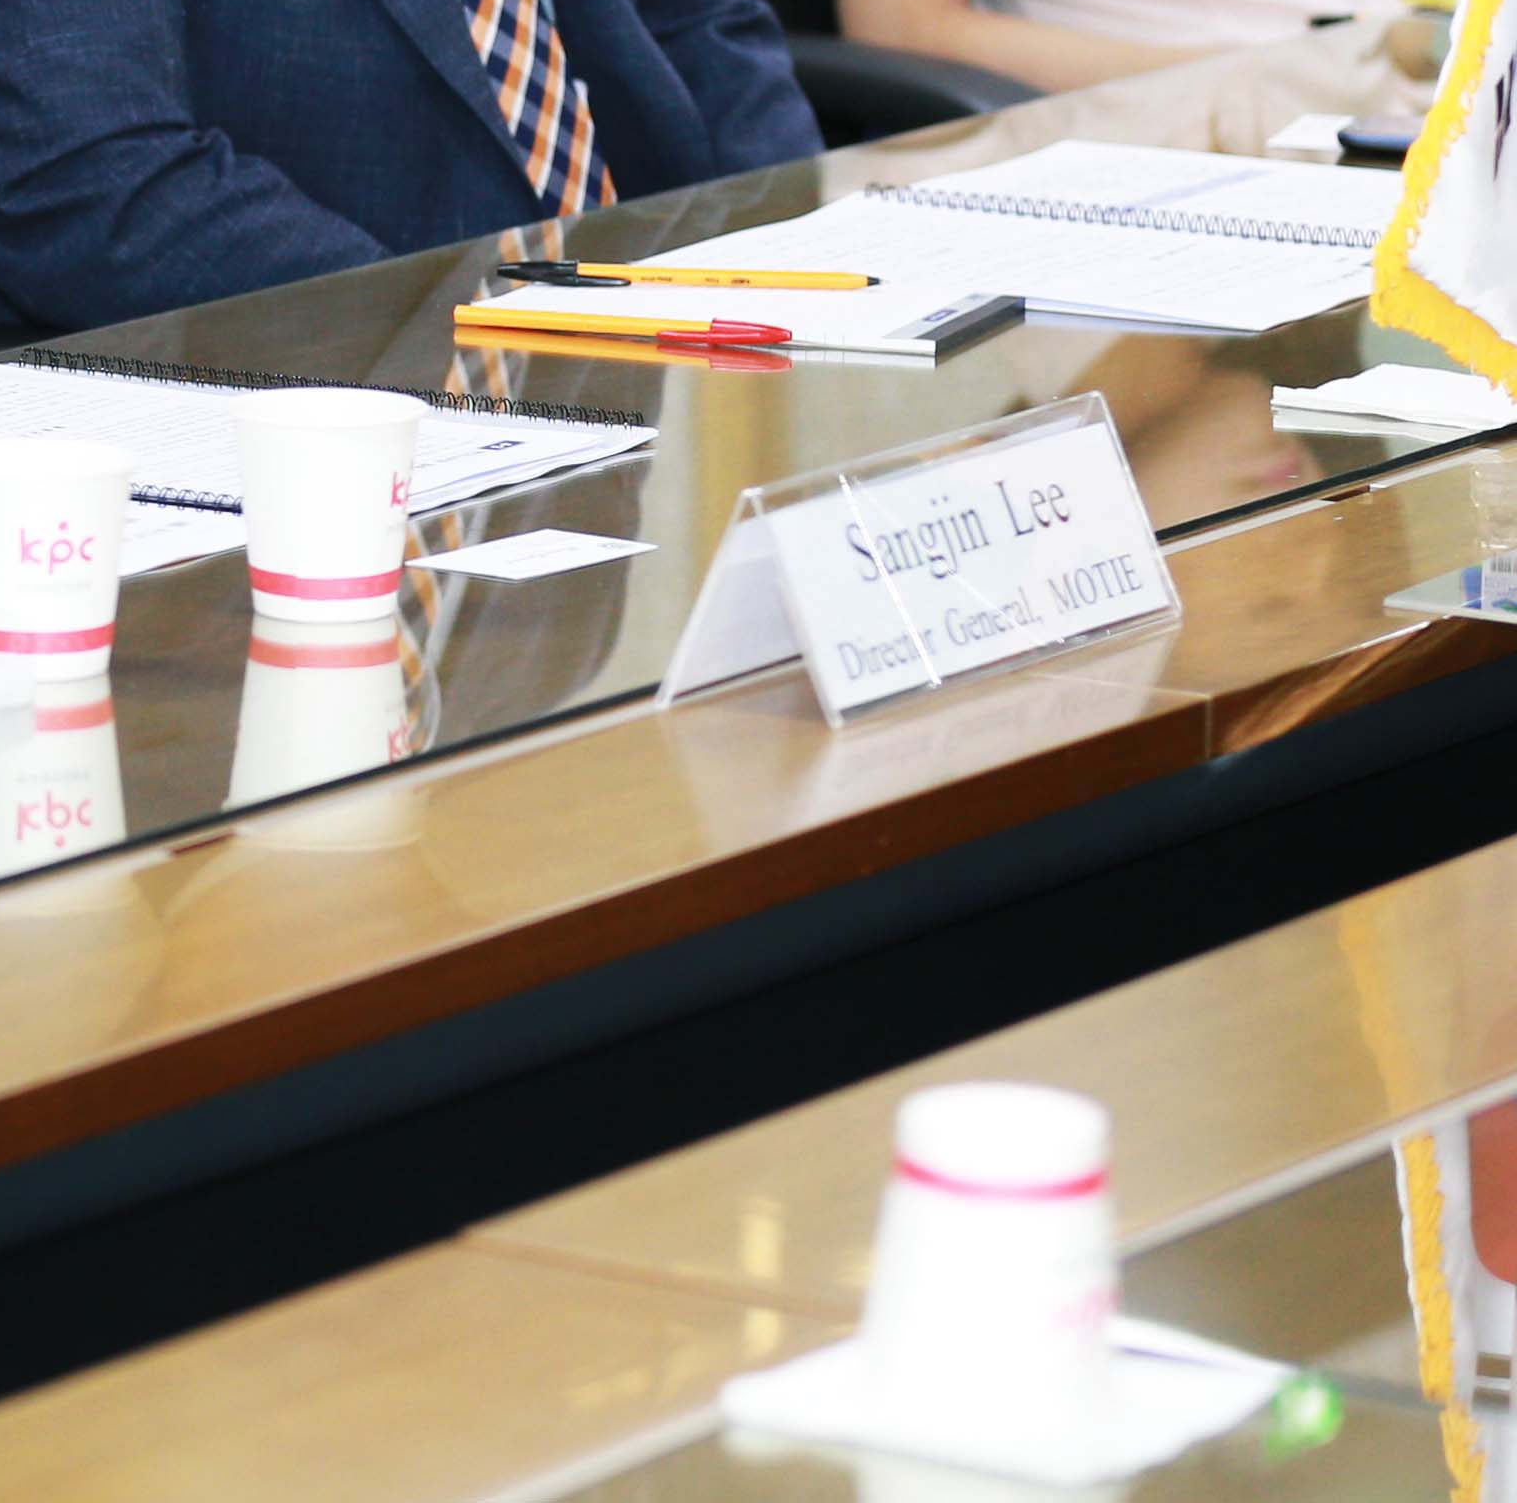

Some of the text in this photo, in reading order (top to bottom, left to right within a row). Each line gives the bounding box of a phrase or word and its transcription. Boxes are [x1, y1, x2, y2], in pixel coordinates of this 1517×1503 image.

[18, 521, 95, 575] kpc
[846, 479, 1070, 581] Sangjin Lee
[1047, 552, 1143, 614] MOTIE
